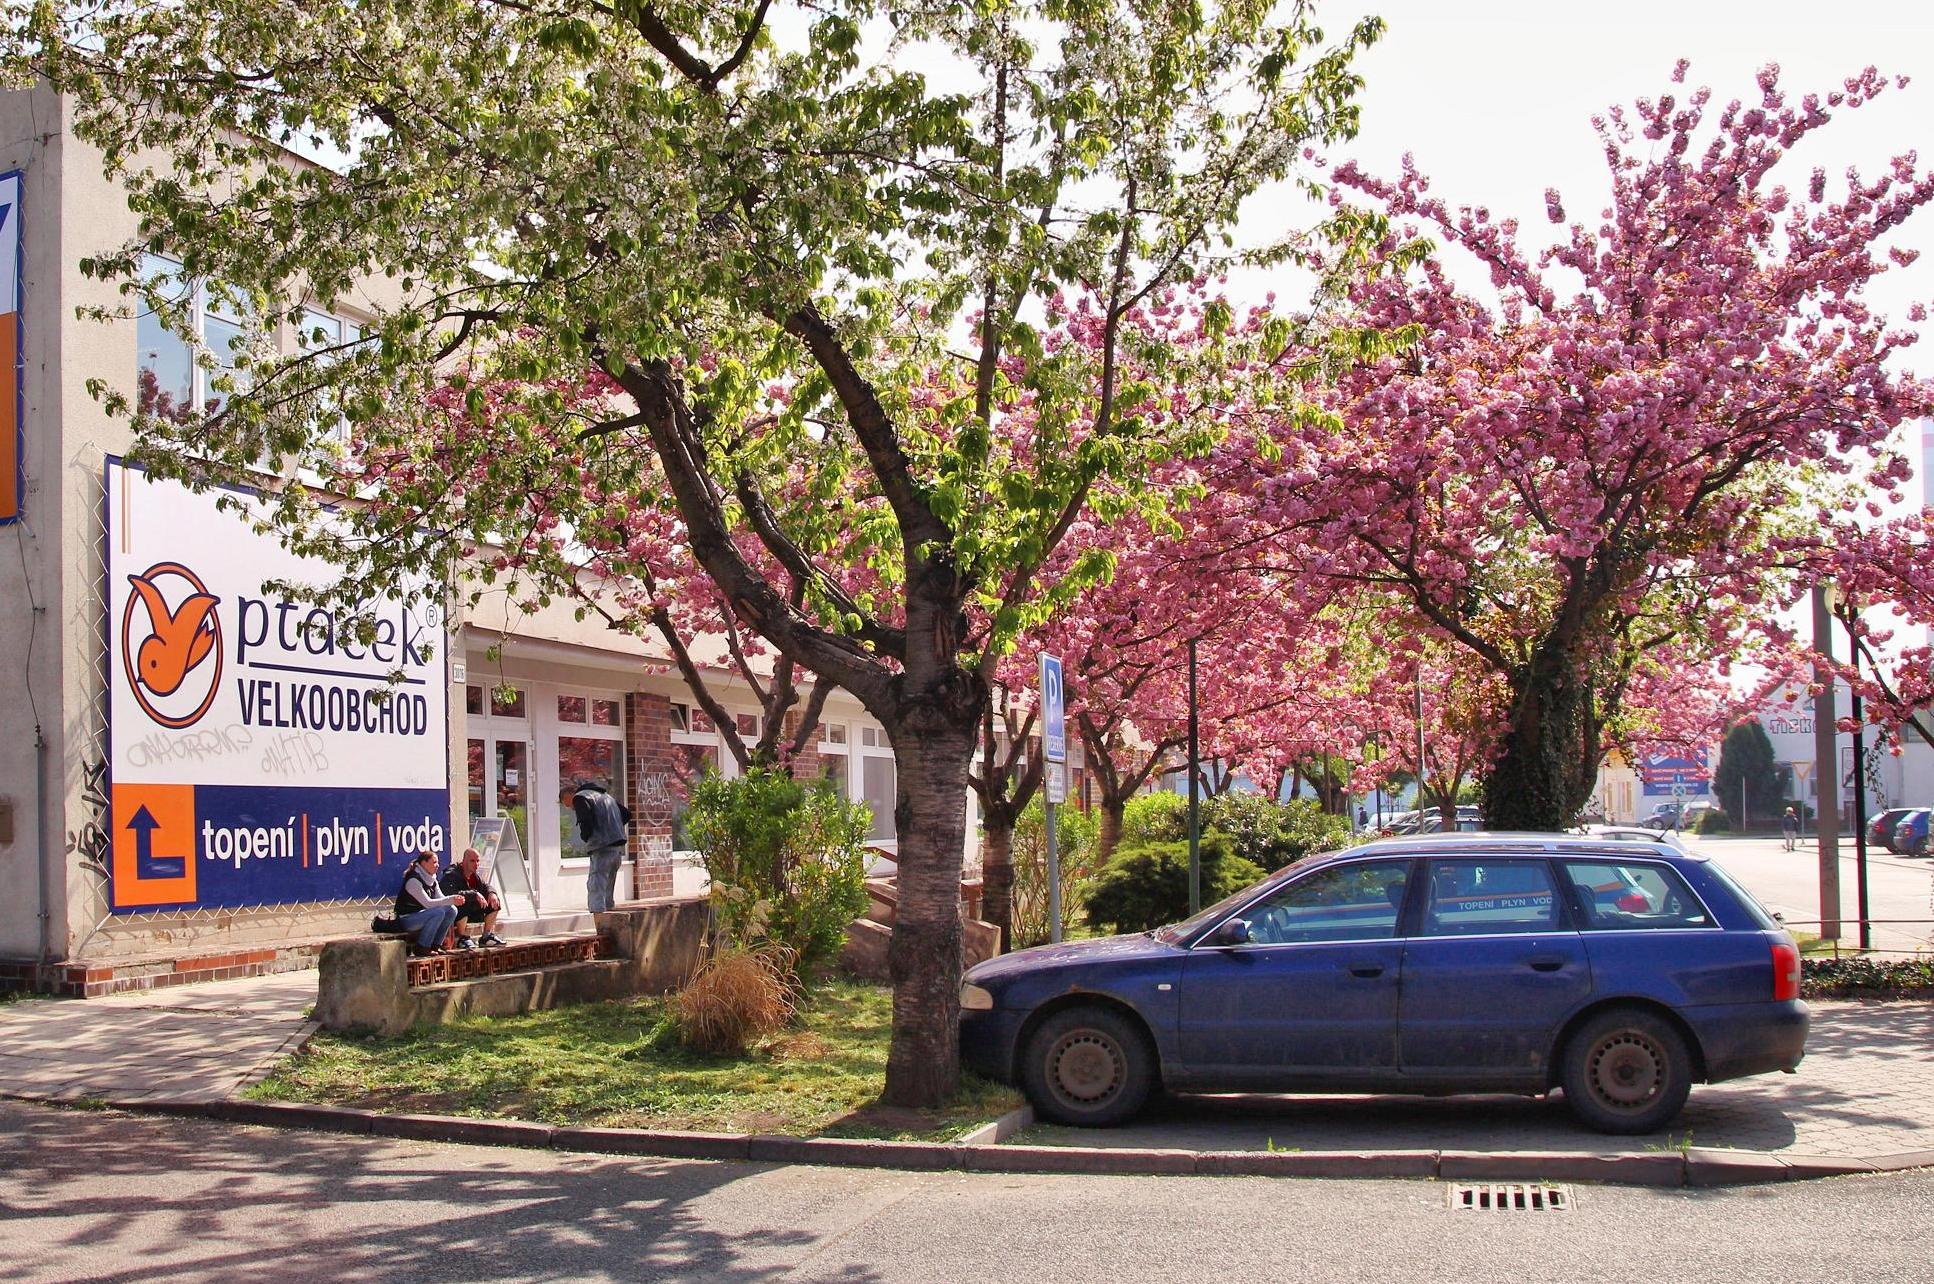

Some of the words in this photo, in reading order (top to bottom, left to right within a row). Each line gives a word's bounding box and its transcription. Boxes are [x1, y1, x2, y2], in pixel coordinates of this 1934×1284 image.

[237, 677, 427, 736] VELKOOBCHOD
[1048, 668, 1058, 723] P
[1770, 718, 1816, 734] TISK
[202, 816, 296, 869] topení
[316, 816, 369, 866] plyn
[388, 815, 444, 854] voda
[1501, 898, 1526, 908] PLYN
